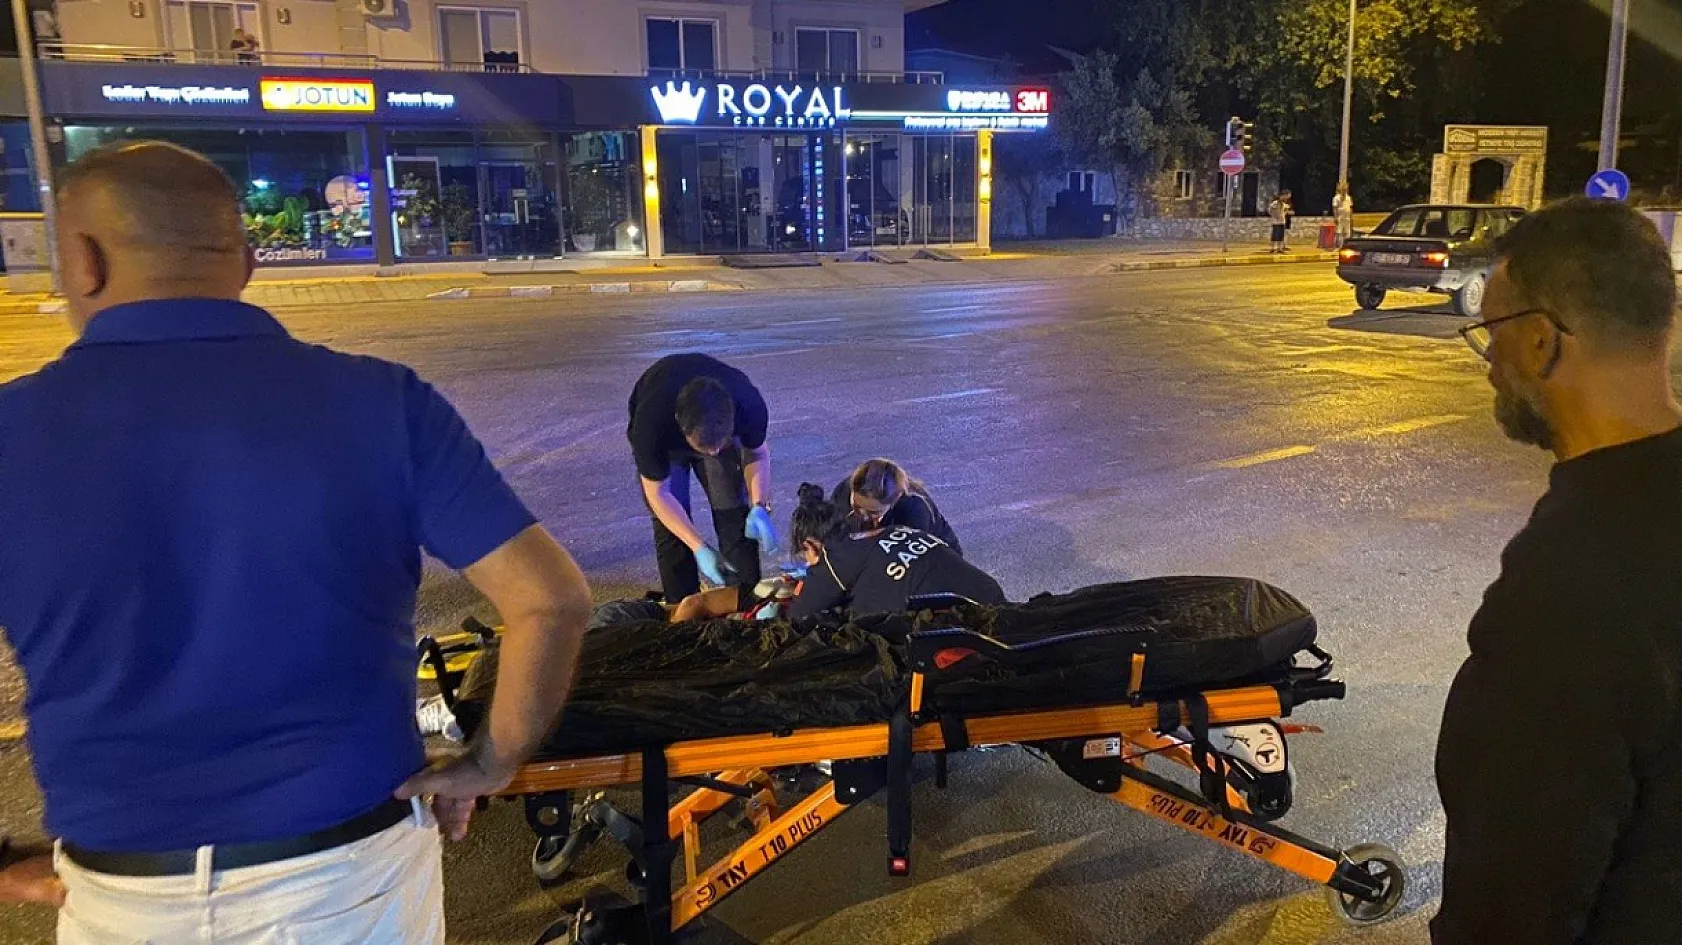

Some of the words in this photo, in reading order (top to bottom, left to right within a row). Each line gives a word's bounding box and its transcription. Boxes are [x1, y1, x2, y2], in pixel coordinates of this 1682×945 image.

[295, 86, 368, 106] JOTUN
[717, 83, 850, 118] ROYAL
[1017, 91, 1048, 111] 3M
[1151, 794, 1184, 819] PLUS
[1218, 823, 1248, 847] TAY
[718, 860, 749, 888] TAY
[788, 808, 822, 843] PLUS
